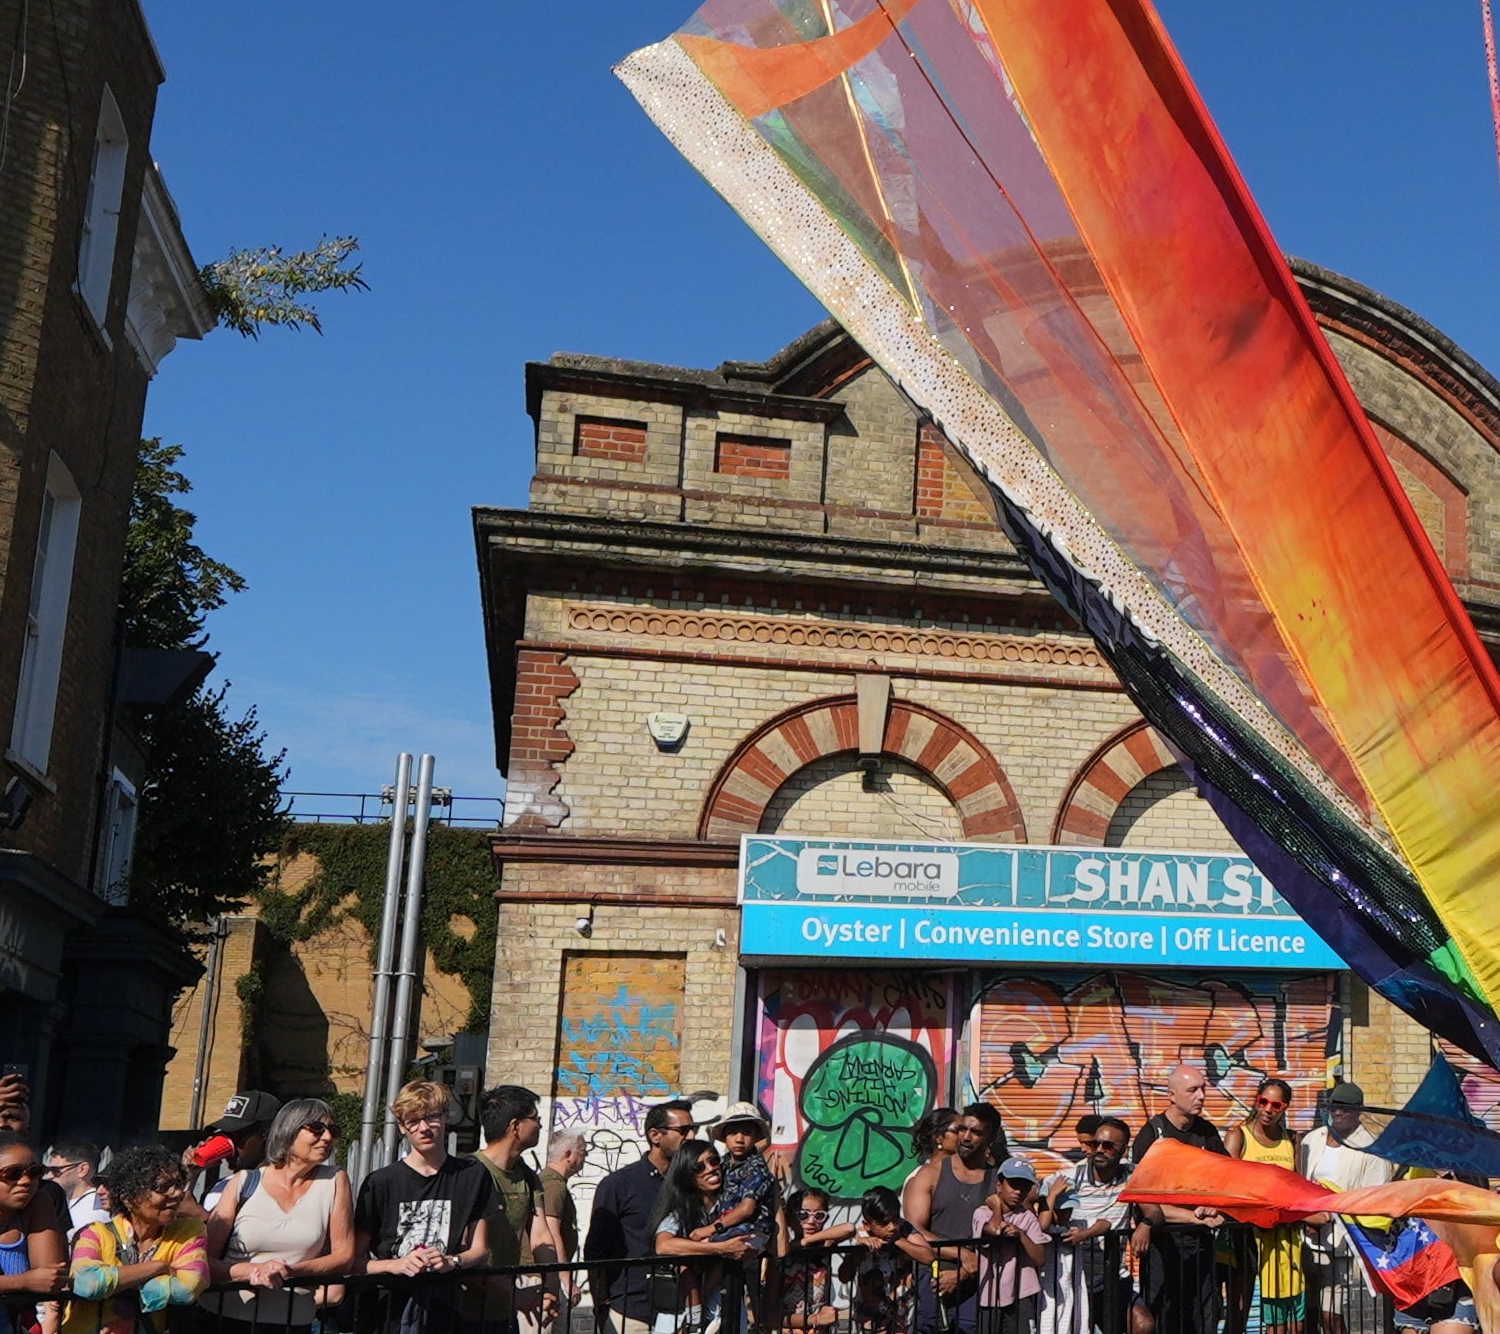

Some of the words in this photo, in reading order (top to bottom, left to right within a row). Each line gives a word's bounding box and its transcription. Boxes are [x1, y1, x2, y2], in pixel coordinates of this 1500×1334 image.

[842, 854, 941, 879] Lebara
[894, 881, 940, 892] mobile
[1074, 859, 1208, 905] SHAN
[802, 917, 893, 947] Oyster
[914, 920, 1080, 948] Convenience
[1087, 925, 1153, 949] Store
[1175, 927, 1212, 951] Off
[1218, 929, 1305, 953] Licence
[815, 1090, 908, 1118] NOTTING
